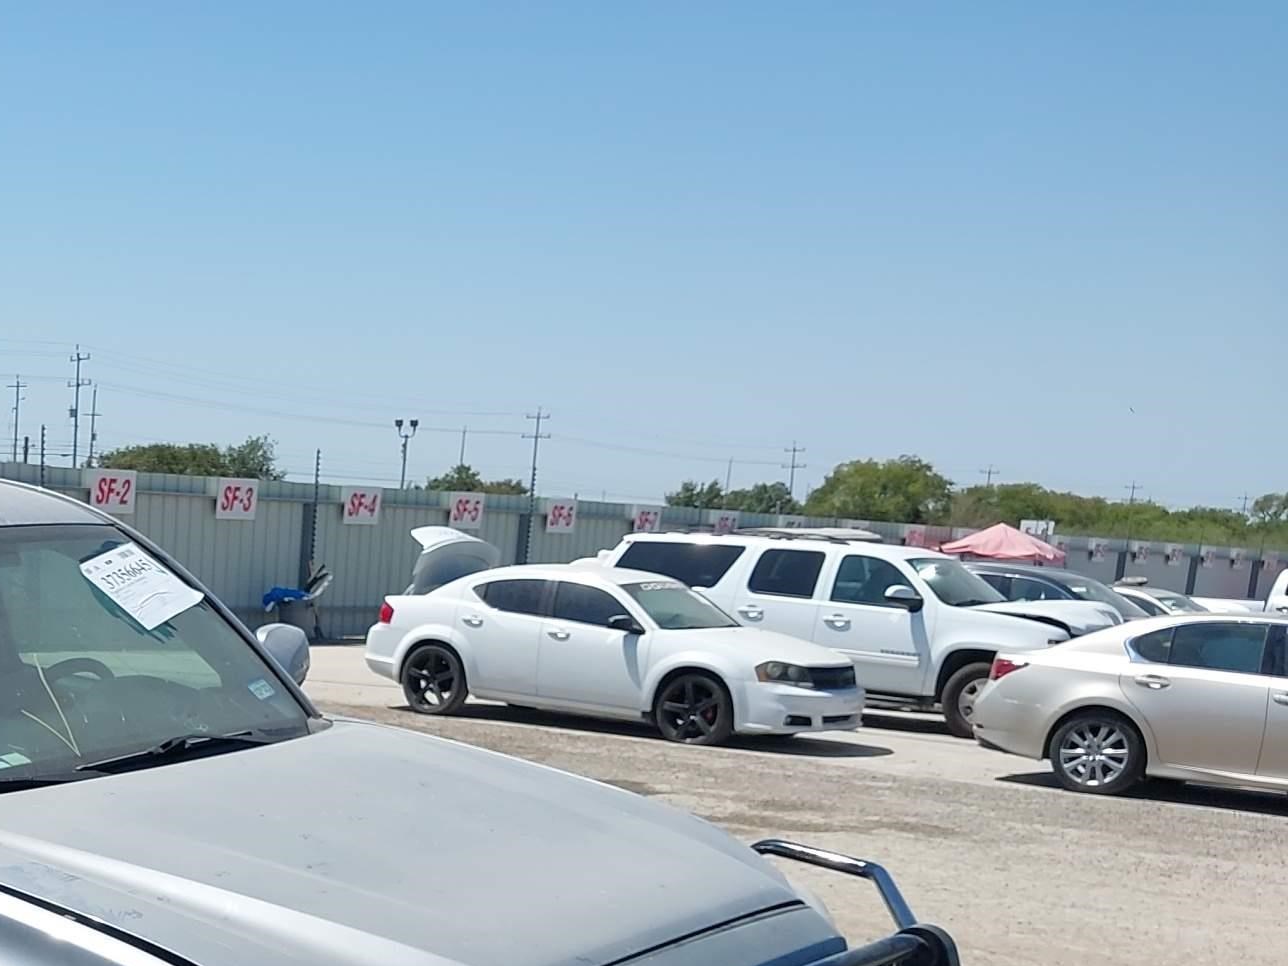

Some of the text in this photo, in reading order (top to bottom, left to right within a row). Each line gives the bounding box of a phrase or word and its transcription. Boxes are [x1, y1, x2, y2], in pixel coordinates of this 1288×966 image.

[96, 477, 131, 505] SF-2
[221, 485, 254, 512] SF-3
[348, 492, 378, 517] SF-4
[453, 498, 480, 522] SF-5
[100, 559, 153, 590] 37356645
